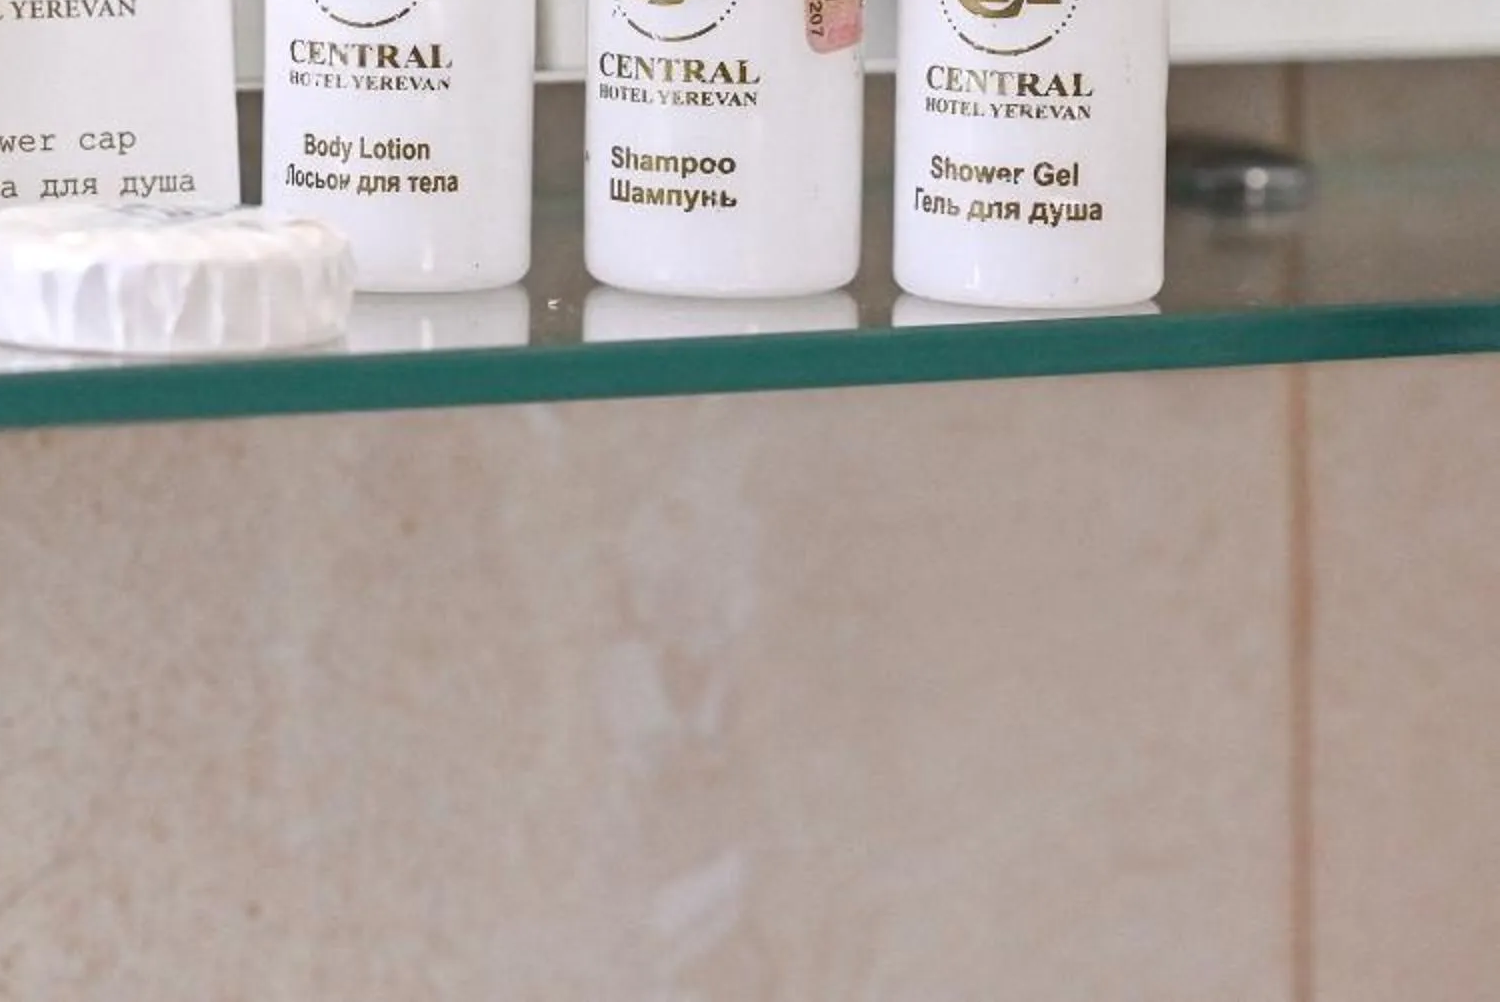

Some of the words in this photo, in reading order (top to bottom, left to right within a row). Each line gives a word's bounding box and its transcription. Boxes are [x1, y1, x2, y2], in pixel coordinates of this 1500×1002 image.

[290, 39, 452, 69] CENTRAL
[599, 52, 760, 85] CENTRAL
[290, 70, 347, 88] HOTEL
[352, 75, 449, 91] YEREVAN
[600, 84, 653, 103] HOTEL
[658, 90, 757, 106] YEREVAN
[926, 65, 1094, 97] CENTRAL
[926, 97, 985, 116] HOTEL
[990, 104, 1090, 120] YEREVAN
[79, 131, 136, 155] cap
[304, 133, 353, 163] Body
[360, 136, 430, 160] Lotion
[611, 146, 736, 178] Shampoo
[930, 154, 1024, 185] Shower
[1033, 162, 1079, 186] Gel
[40, 178, 98, 199] для
[119, 174, 196, 198] душа
[286, 162, 350, 190] Лосьон
[356, 175, 401, 196] для
[407, 175, 458, 194] тела
[610, 178, 737, 212] Шампунь
[915, 186, 960, 216] Гель
[967, 200, 1020, 222] для
[1028, 202, 1102, 228] душа
